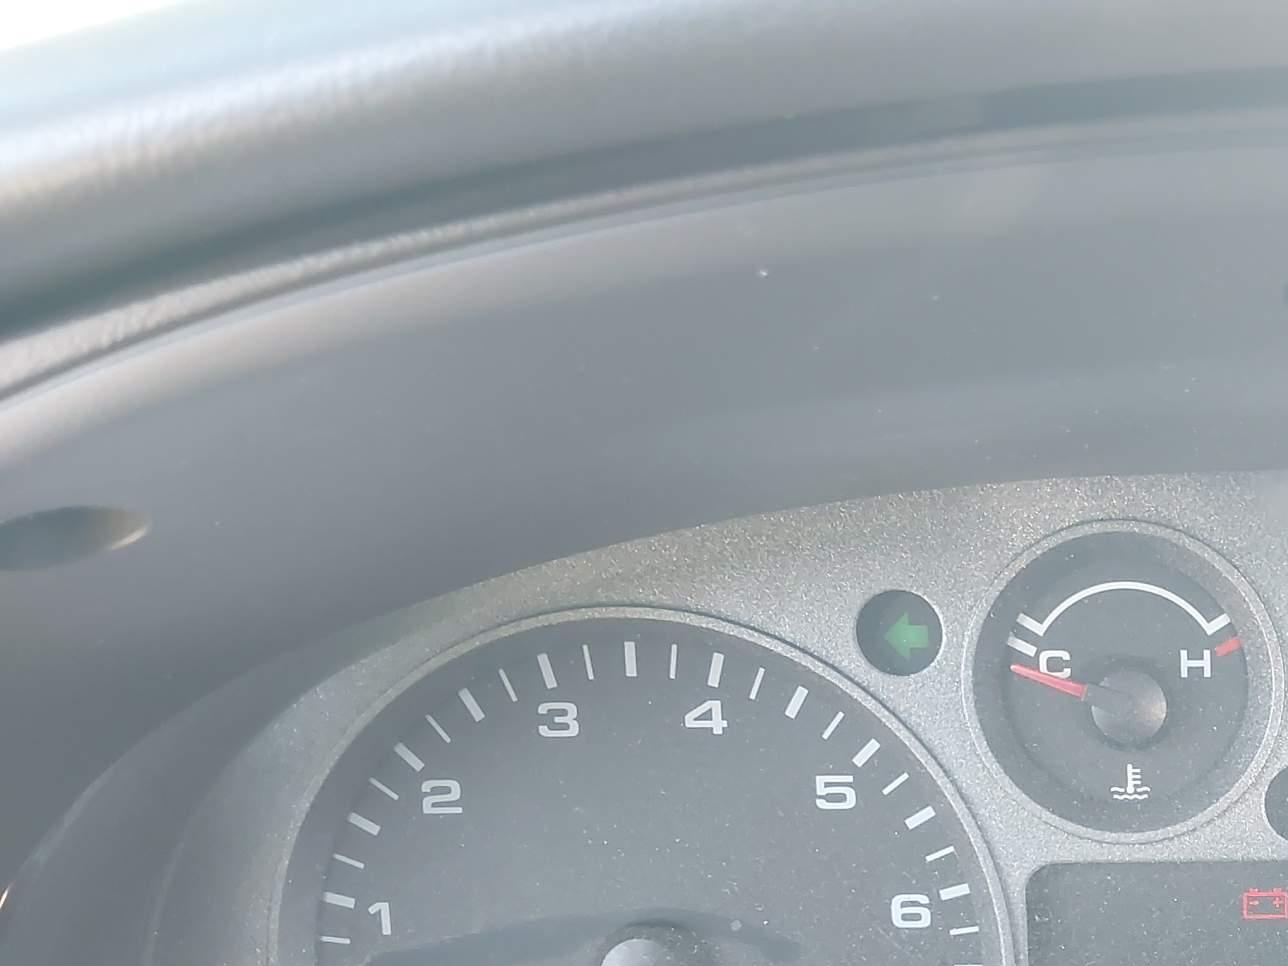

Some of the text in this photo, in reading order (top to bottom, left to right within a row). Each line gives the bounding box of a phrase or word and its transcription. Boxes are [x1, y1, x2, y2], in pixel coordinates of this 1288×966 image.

[1038, 649, 1211, 679] C H
[537, 702, 580, 738] 3
[684, 700, 728, 735] 4
[421, 779, 463, 814] 2
[815, 775, 857, 810] 5
[367, 902, 392, 936] 1
[890, 893, 931, 928] 6
